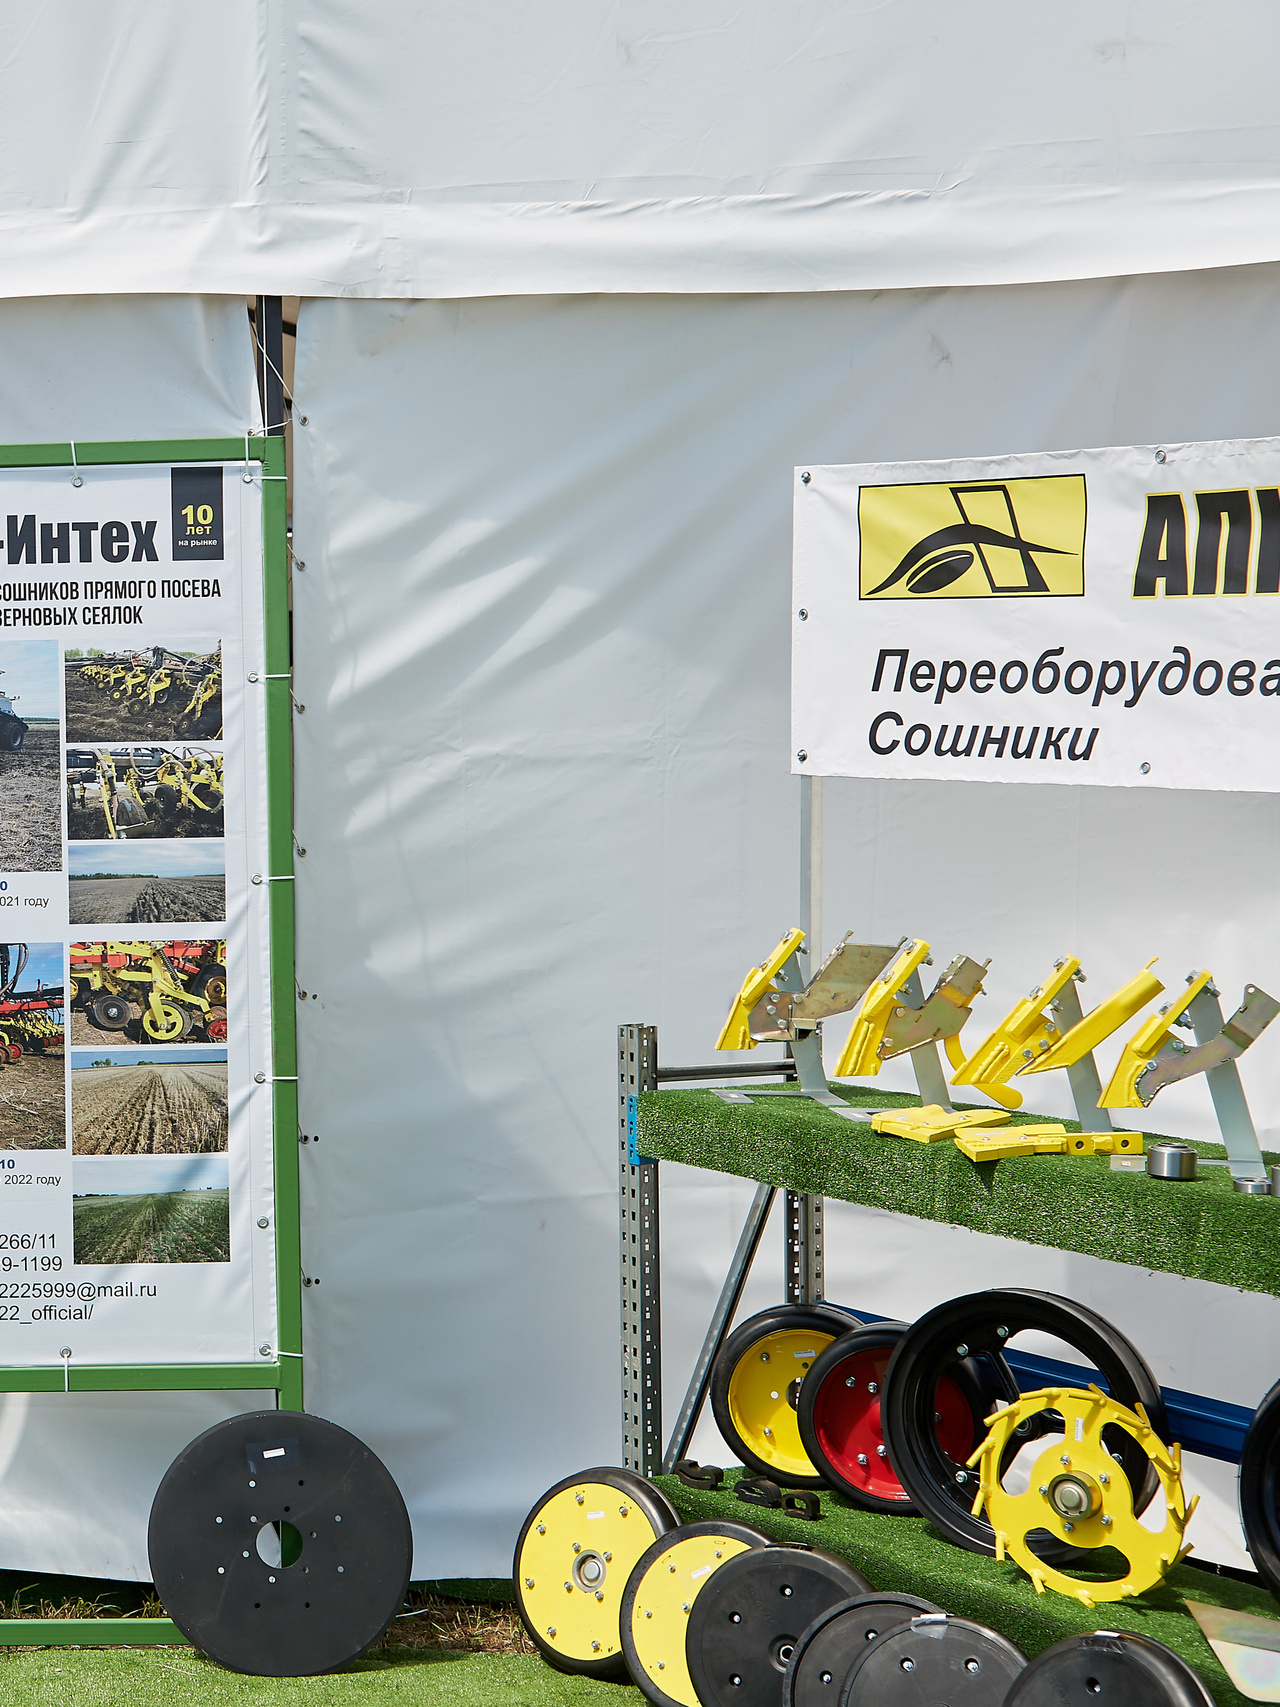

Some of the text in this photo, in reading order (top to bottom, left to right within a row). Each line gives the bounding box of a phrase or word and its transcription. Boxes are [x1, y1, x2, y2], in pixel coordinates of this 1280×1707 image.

[181, 504, 214, 526] 10
[186, 525, 213, 536] лет
[190, 538, 218, 548] рынке
[83, 579, 157, 600] ПРЯМОГО
[161, 578, 222, 599] ПОСЕВА
[82, 605, 143, 626] СЕЯЛОК
[871, 645, 1280, 709] Переоборудова
[868, 710, 1100, 762] Сошники
[24, 897, 50, 909] году
[4, 1174, 33, 1185] 2022
[36, 1176, 62, 1187] году
